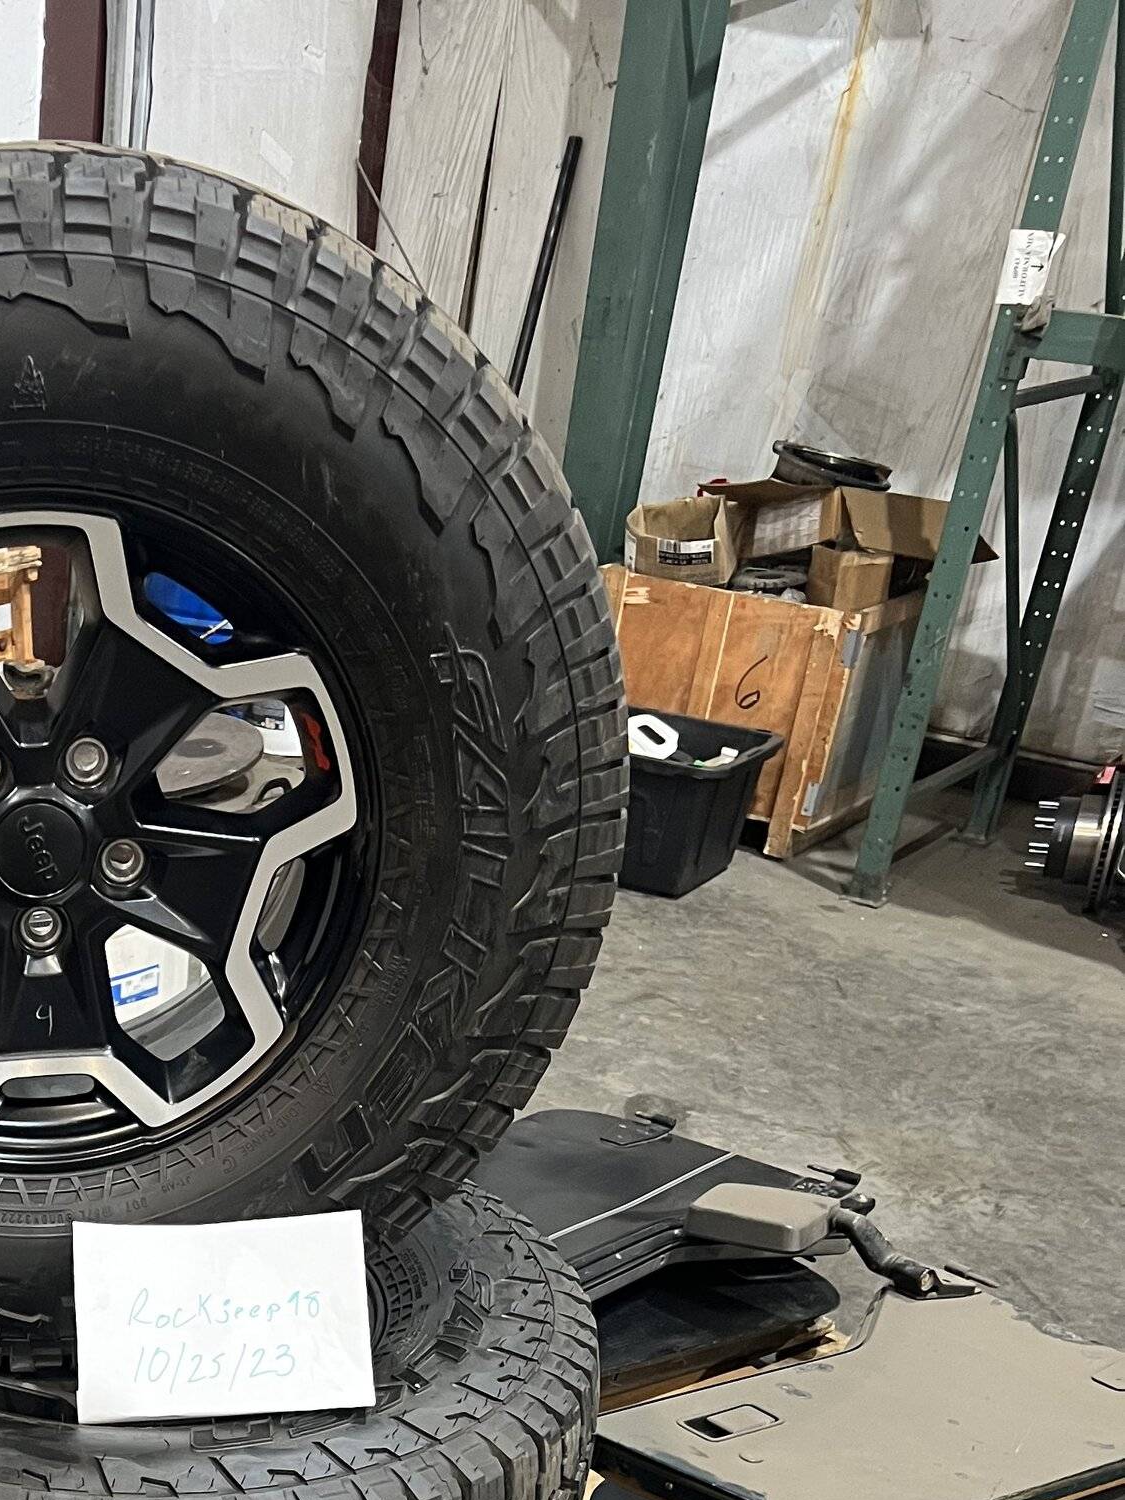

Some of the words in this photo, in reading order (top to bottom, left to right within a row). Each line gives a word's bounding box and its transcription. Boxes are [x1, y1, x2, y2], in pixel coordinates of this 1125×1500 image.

[735, 654, 768, 709] 6
[17, 815, 61, 880] Jeep
[288, 621, 512, 1197] FALKEN
[133, 1341, 296, 1395] 10/25/23
